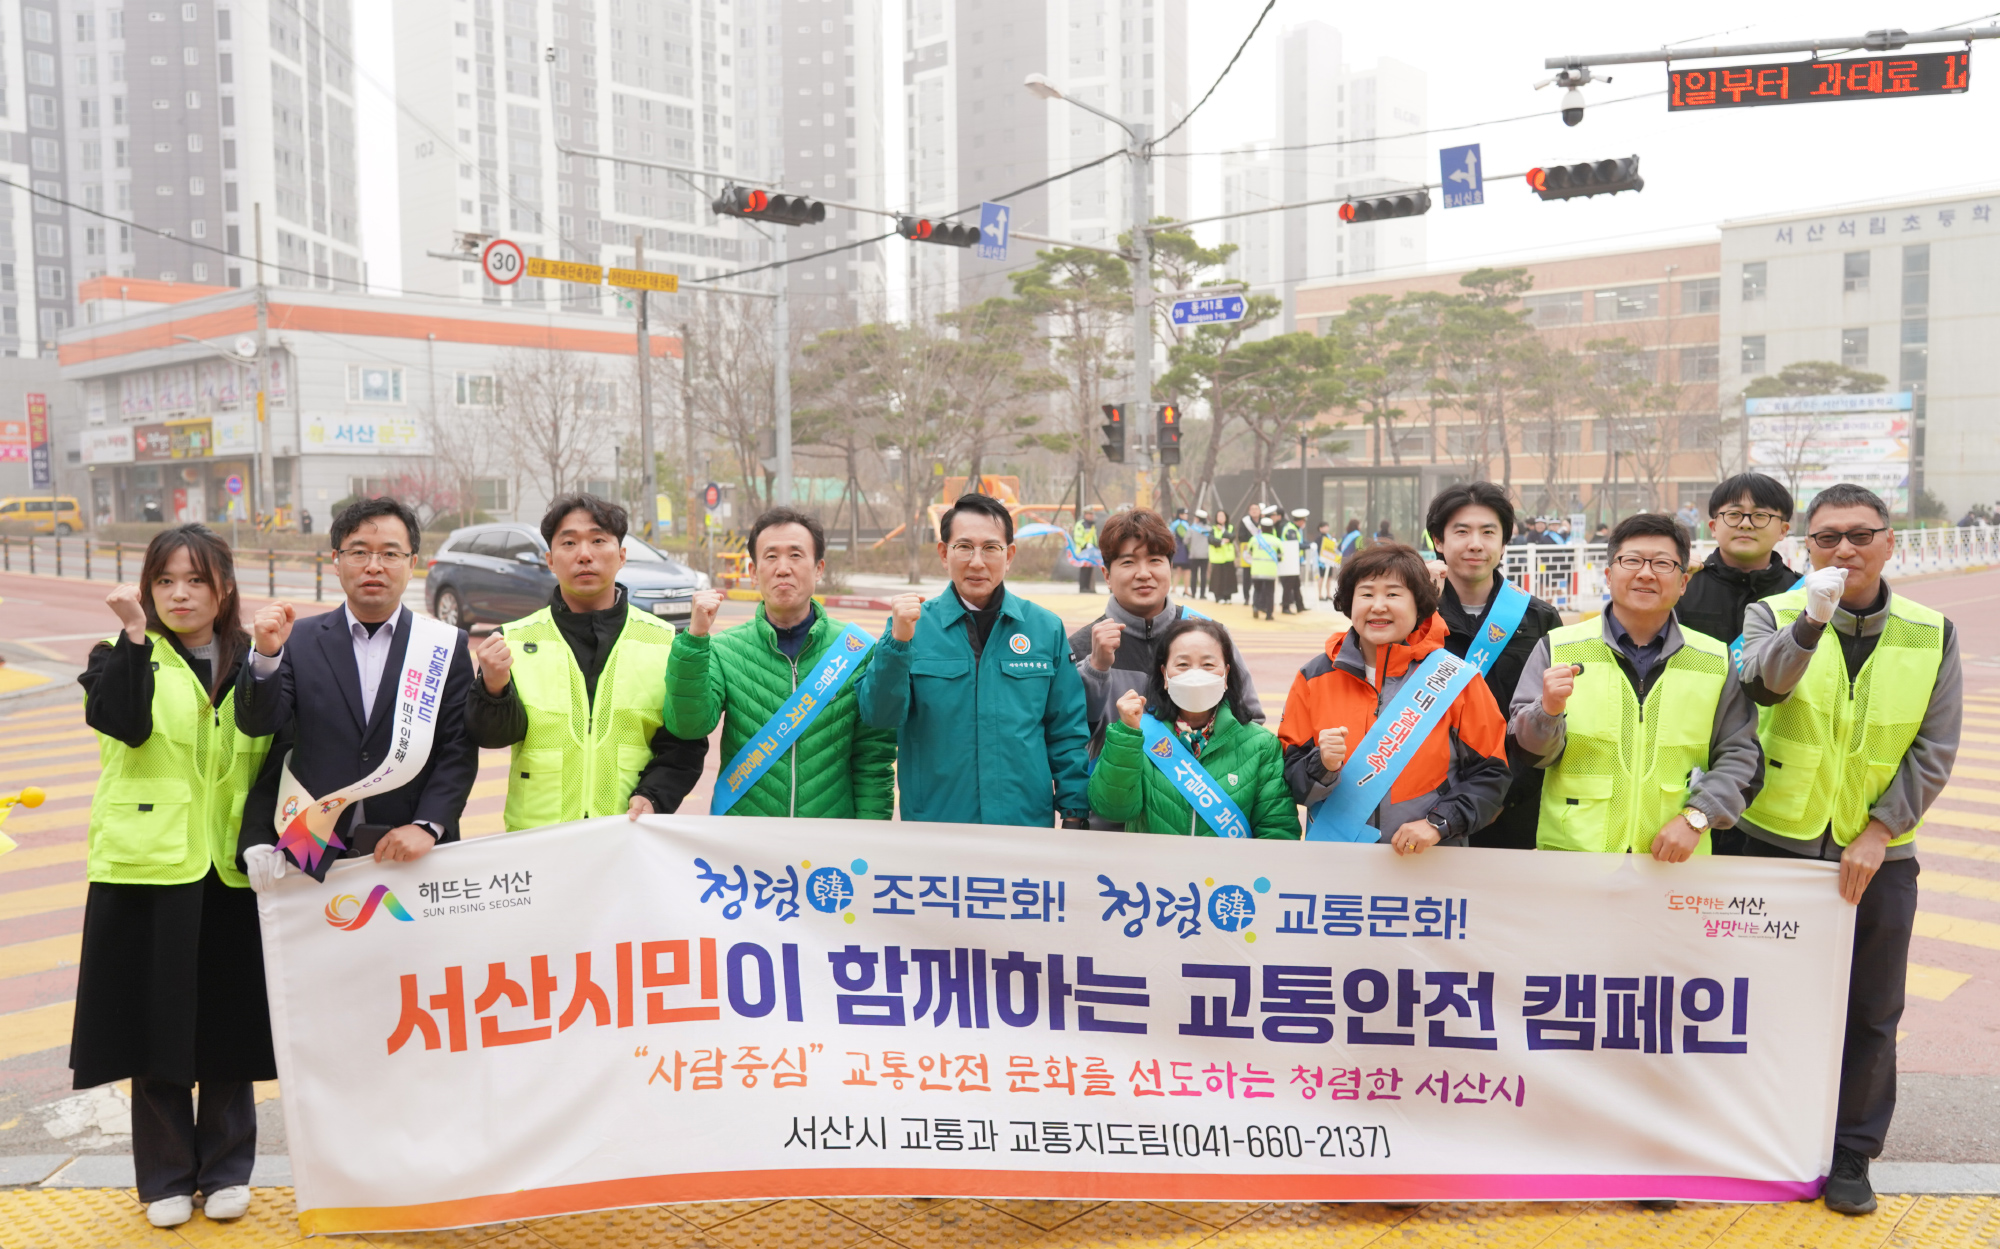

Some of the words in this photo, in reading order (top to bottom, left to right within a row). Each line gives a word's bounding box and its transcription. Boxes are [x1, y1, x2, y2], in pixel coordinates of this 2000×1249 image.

[1810, 60, 1920, 96] 과태료
[414, 141, 435, 159] 102
[1444, 190, 1482, 208] 동시신호
[492, 252, 517, 272] 30
[1191, 299, 1224, 315] 동서1로
[404, 668, 423, 701] 면허
[416, 645, 449, 723] 전동킥보드
[814, 655, 849, 697] 사람이
[401, 702, 414, 726] 따고
[776, 693, 818, 739] 먼저인
[1413, 689, 1436, 712] 내
[726, 736, 779, 793] 교통문화
[1173, 759, 1223, 808] 사람이
[418, 878, 482, 904] 해뜨는
[488, 870, 533, 895] 서산
[423, 907, 445, 918] SUN
[449, 902, 486, 915] RISING
[489, 896, 532, 910] SEOSAN
[872, 874, 1065, 923] 조직문화!
[1275, 893, 1468, 940] 교통문화!
[1667, 895, 1725, 914] 도약하는
[1728, 897, 1768, 917] 서산,
[1703, 920, 1760, 938] 살맛나는
[1763, 920, 1800, 940] 서산
[387, 937, 805, 1056] 서산시민이
[828, 943, 1151, 1036] 함께하는
[1178, 963, 1499, 1052] 교통안전
[1521, 973, 1750, 1055] 캠페인
[842, 1051, 992, 1093] 교통안전
[1005, 1055, 1116, 1097] 문화를
[1129, 1059, 1276, 1100] 선도하는
[1289, 1064, 1404, 1101] 청렴한
[1415, 1070, 1527, 1108] 서산시
[784, 1116, 888, 1150] 서산시
[900, 1118, 999, 1153] 교통과
